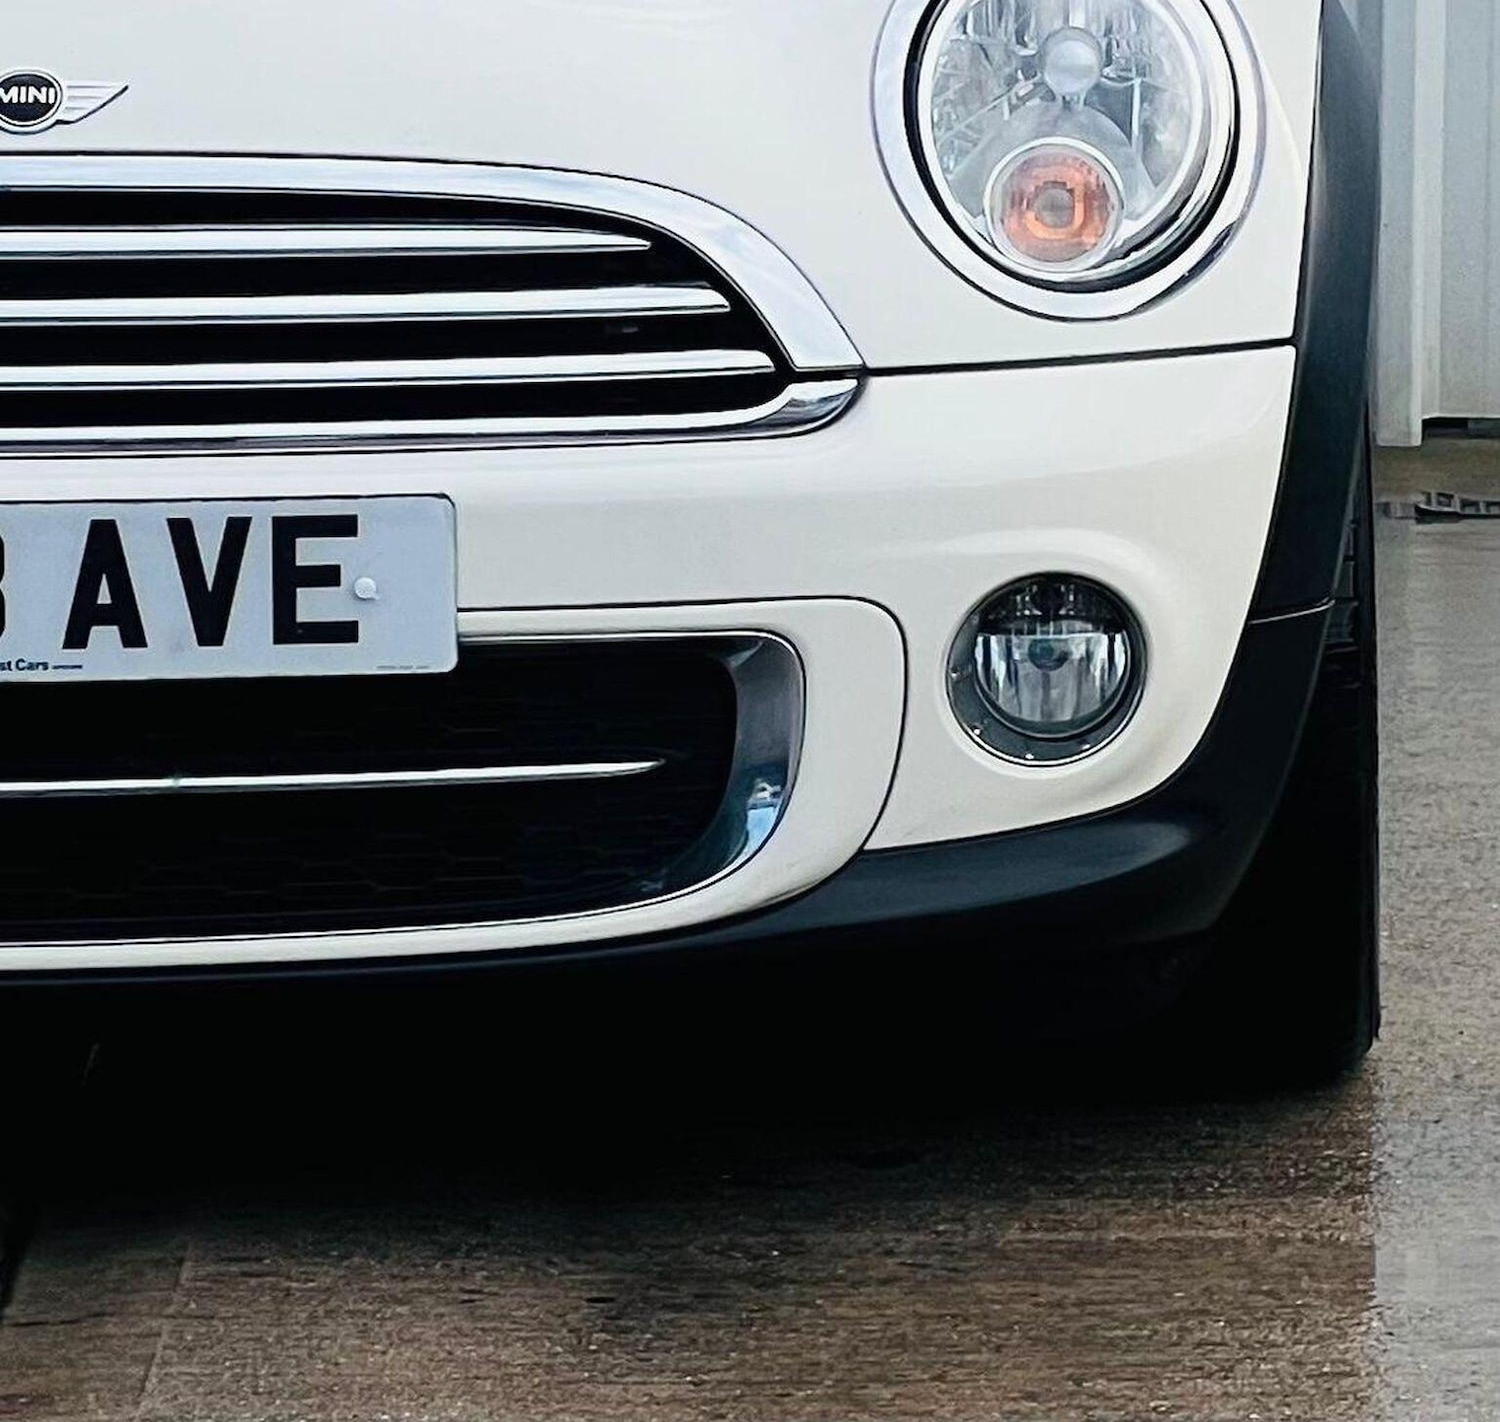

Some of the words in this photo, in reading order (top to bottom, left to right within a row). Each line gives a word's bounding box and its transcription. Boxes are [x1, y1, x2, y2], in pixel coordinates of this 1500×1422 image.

[0, 86, 55, 104] MINI
[62, 514, 359, 650] AVE
[15, 658, 49, 671] Cars
